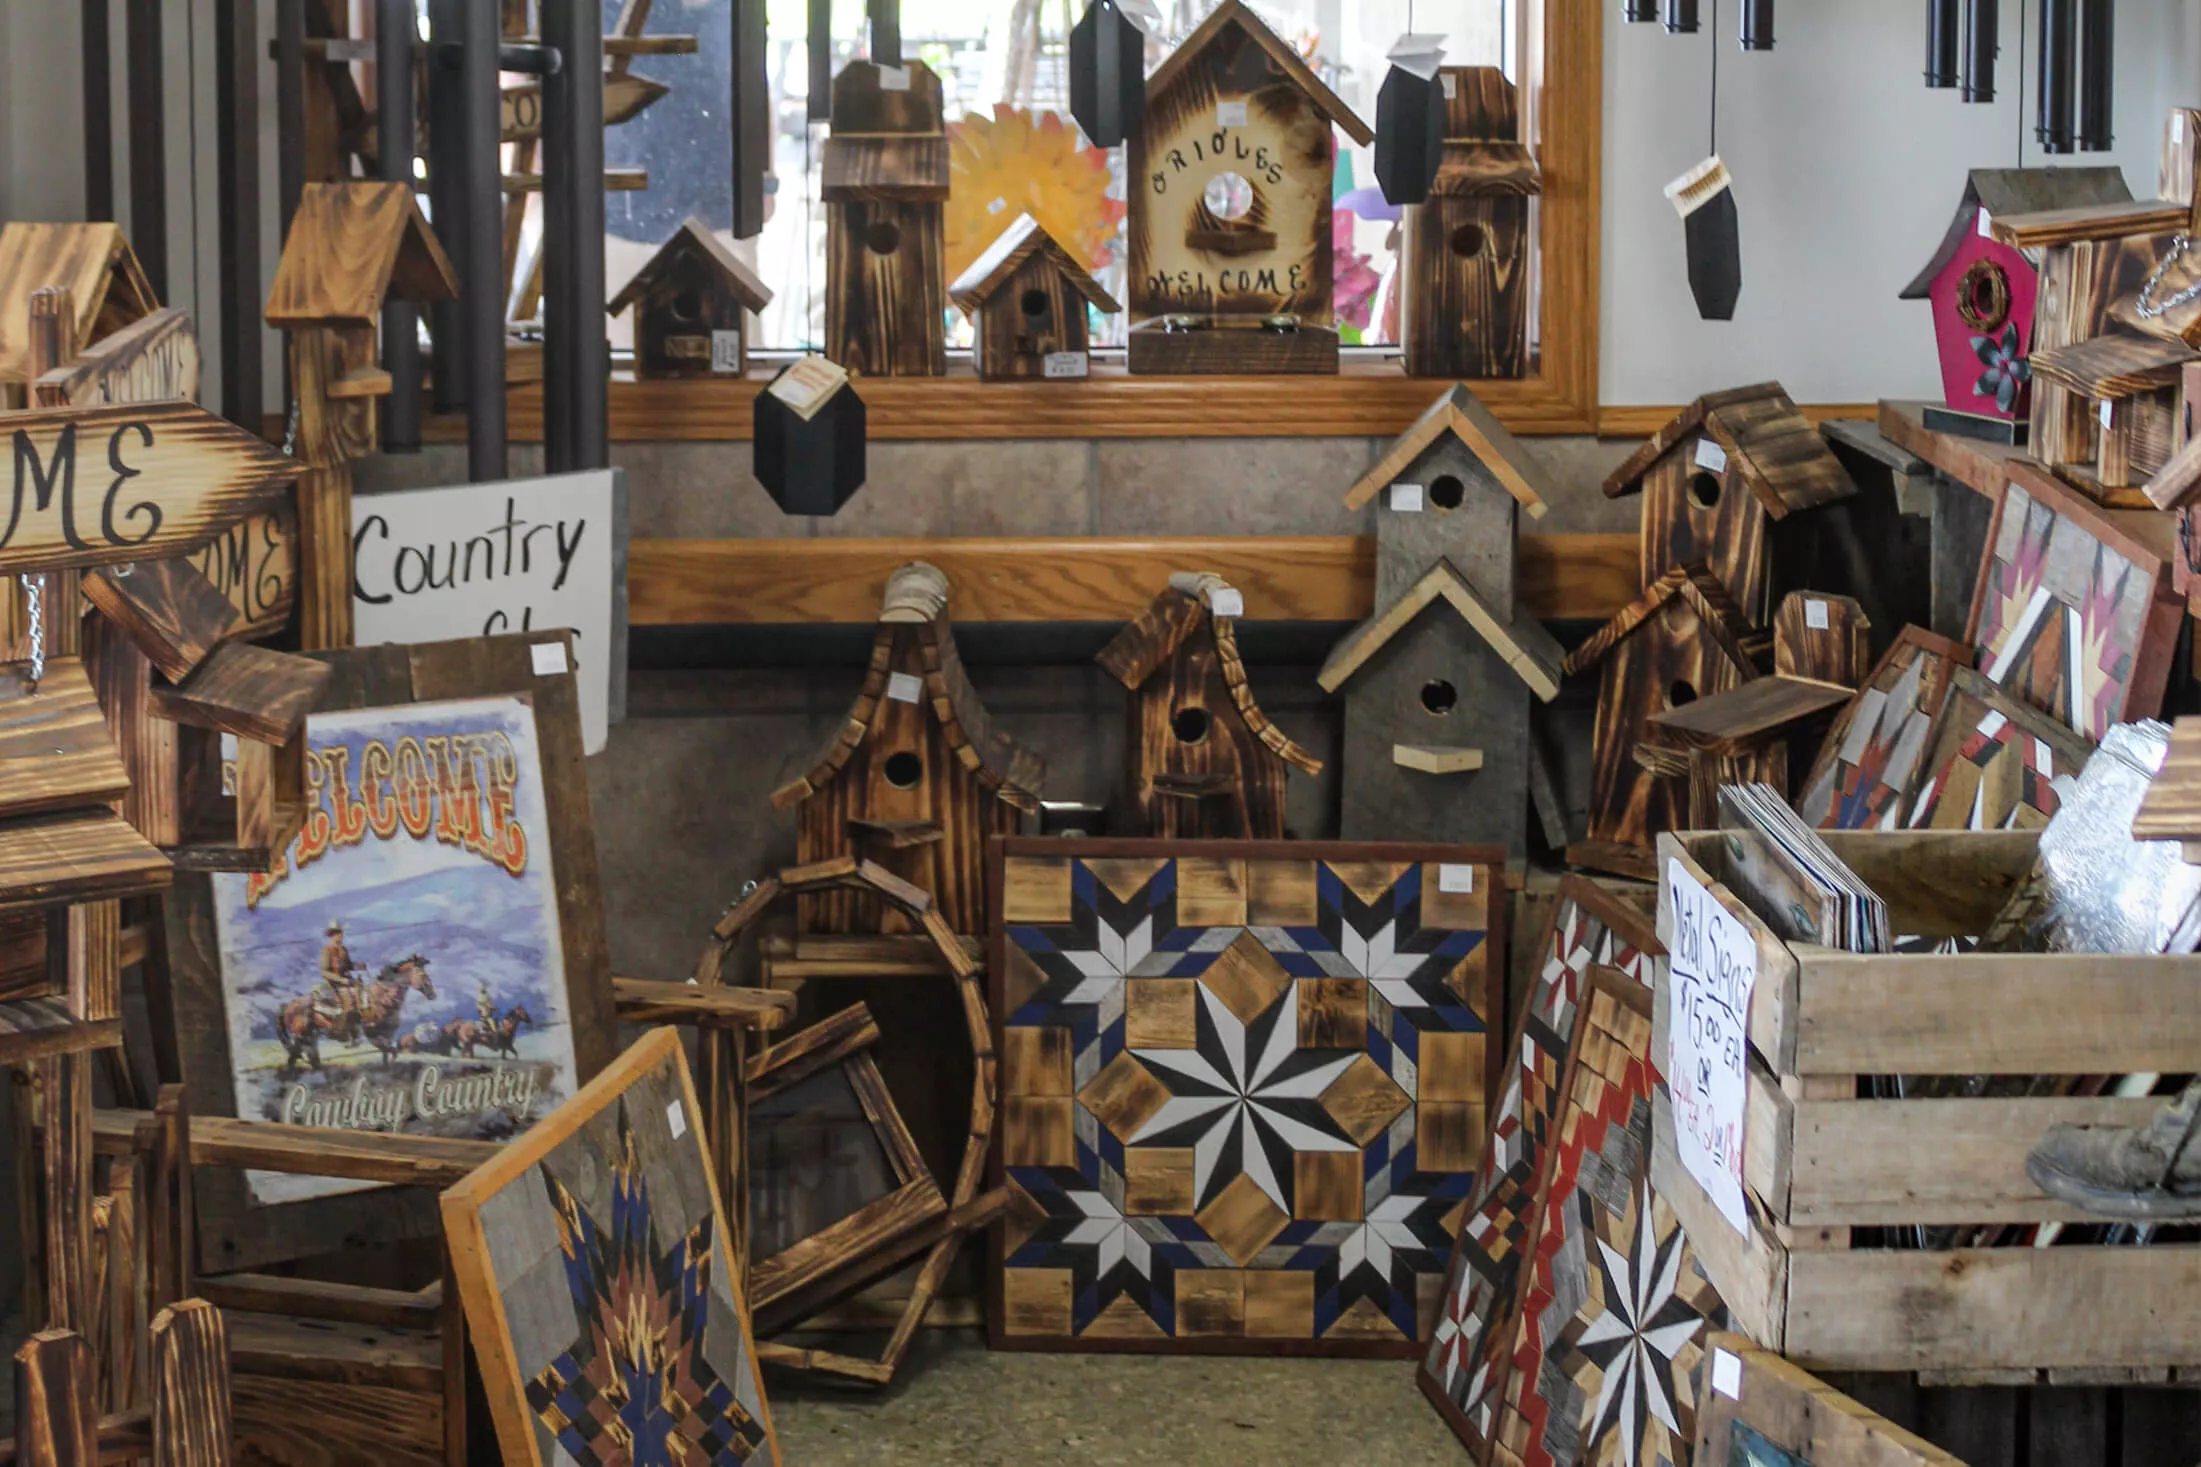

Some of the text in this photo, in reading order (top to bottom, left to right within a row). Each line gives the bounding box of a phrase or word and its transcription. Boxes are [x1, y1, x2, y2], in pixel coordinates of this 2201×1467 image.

[1151, 127, 1283, 195] ORIOLES
[352, 497, 586, 605] Country
[247, 729, 528, 911] ELCOME
[415, 1064, 536, 1120] Country
